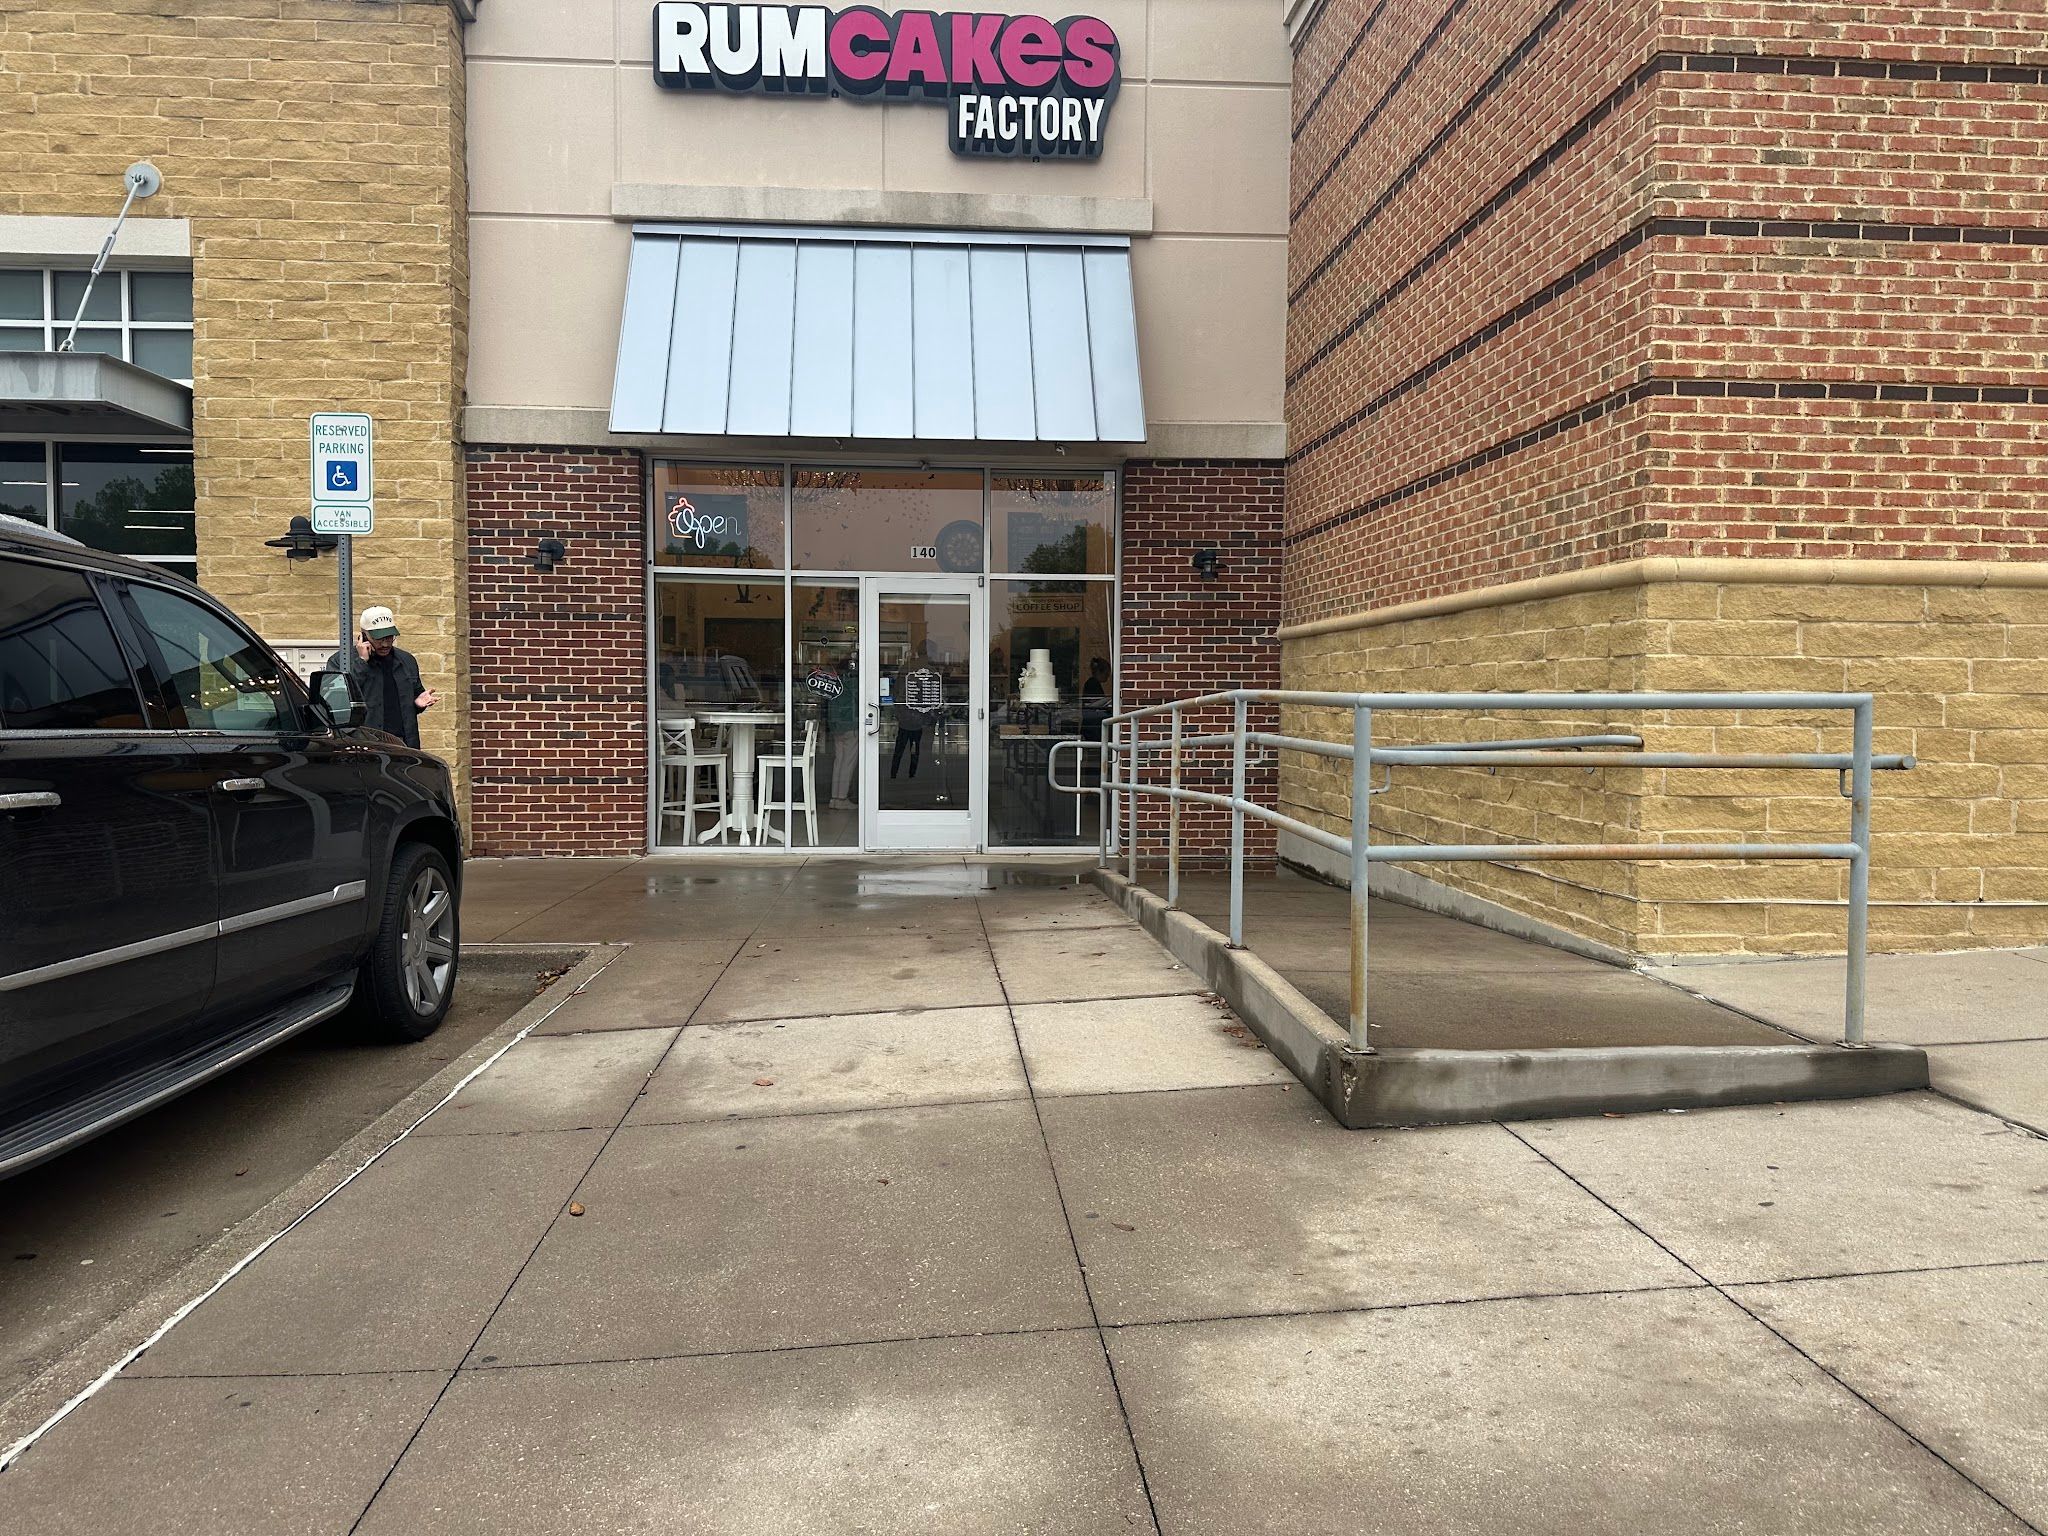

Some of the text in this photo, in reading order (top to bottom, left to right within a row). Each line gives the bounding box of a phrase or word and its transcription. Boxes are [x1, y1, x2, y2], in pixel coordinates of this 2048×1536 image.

[958, 95, 1104, 141] FACTORY
[315, 424, 367, 437] RESERVED
[319, 442, 364, 454] PARKING
[676, 508, 741, 549] Open
[912, 547, 936, 558] 140
[1016, 602, 1080, 611] COFFEE SHOP
[808, 678, 841, 695] OPEN
